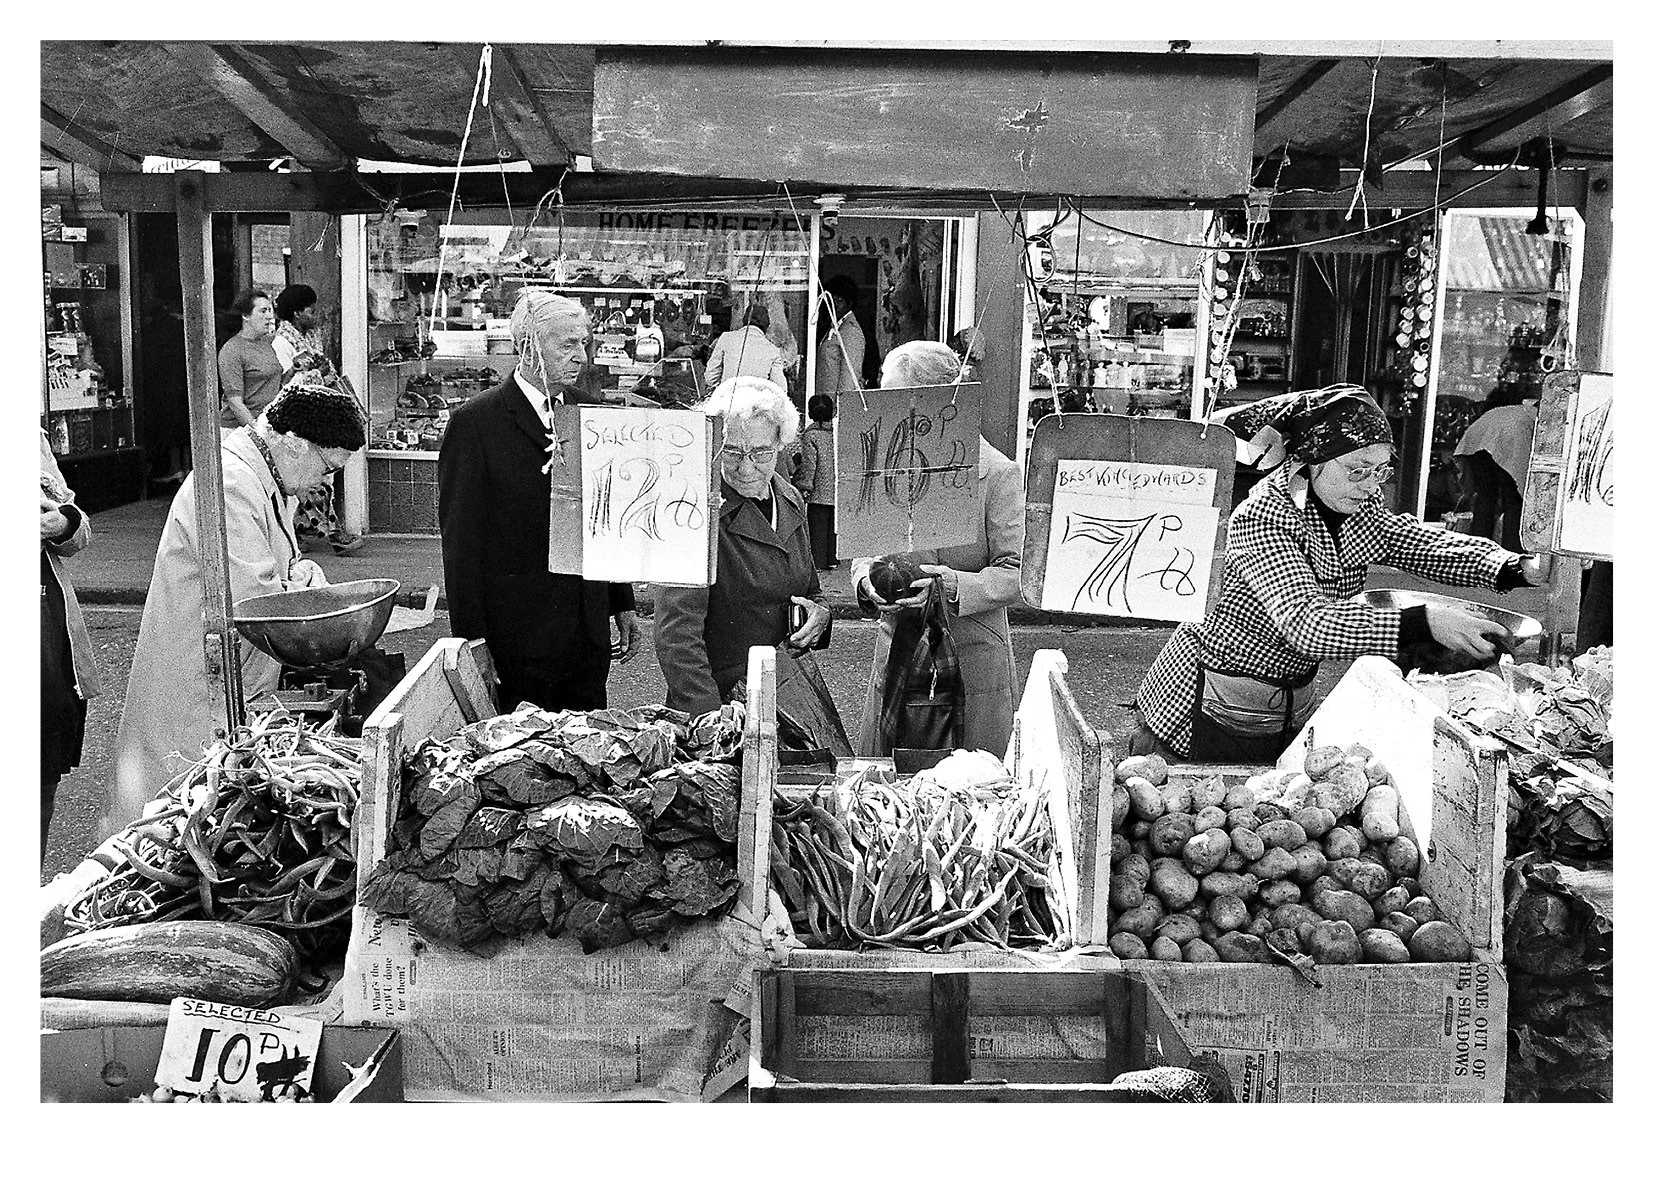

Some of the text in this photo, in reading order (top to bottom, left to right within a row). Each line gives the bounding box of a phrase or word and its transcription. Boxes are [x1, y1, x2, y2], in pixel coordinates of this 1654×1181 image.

[584, 419, 695, 450] SELECTED
[1059, 466, 1094, 487] BEST
[370, 962, 381, 1011] What's the
[383, 957, 395, 1018] TGWU done
[397, 965, 406, 1011] for them?
[182, 1000, 281, 1024] SELECTED
[1472, 963, 1490, 1080] COME OUT OF
[1454, 996, 1471, 1077] SHADOWS
